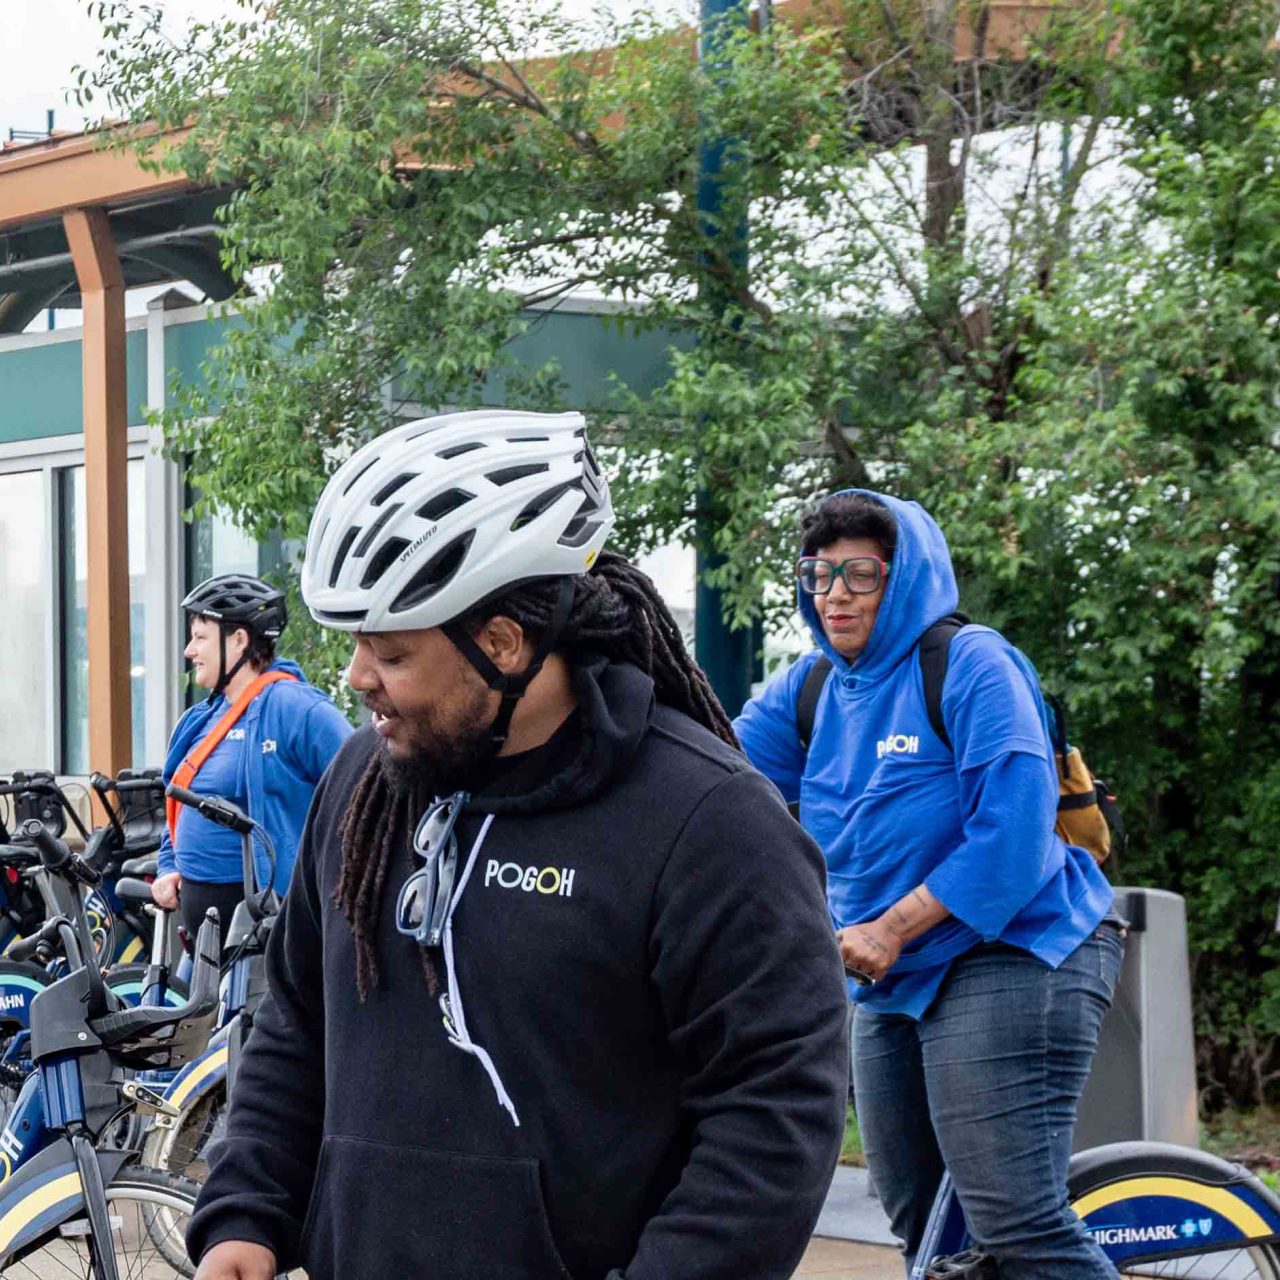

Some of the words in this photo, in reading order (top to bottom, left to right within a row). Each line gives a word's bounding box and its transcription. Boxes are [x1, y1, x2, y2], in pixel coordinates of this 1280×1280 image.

[400, 524, 438, 562] SPECIALIZED
[876, 734, 919, 759] PGOH
[484, 859, 576, 897] POGOH
